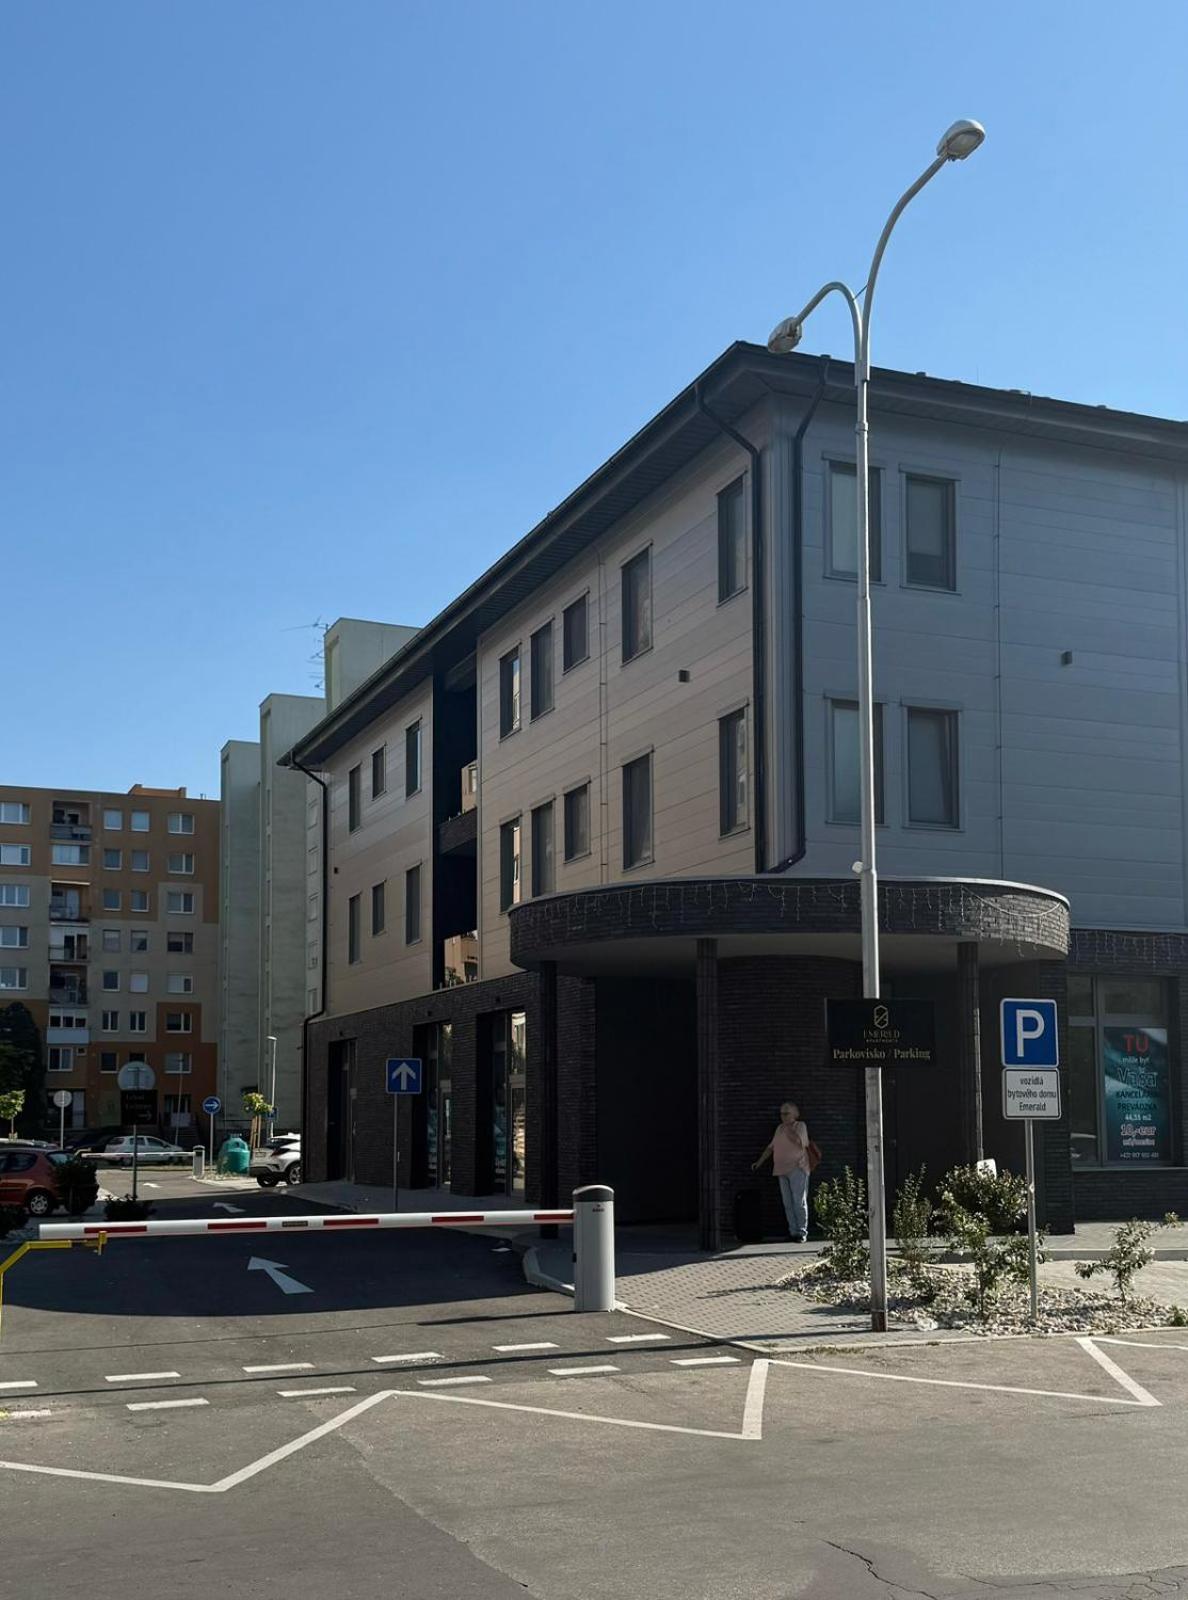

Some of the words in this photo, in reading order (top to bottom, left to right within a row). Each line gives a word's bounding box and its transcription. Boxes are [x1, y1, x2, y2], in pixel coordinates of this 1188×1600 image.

[1016, 1009, 1045, 1057] P
[1123, 1034, 1149, 1052] TU
[833, 1048, 886, 1059] Parkovisko
[894, 1048, 931, 1060] Parking
[1039, 1089, 1057, 1098] domu
[1019, 1102, 1046, 1111] Emerald
